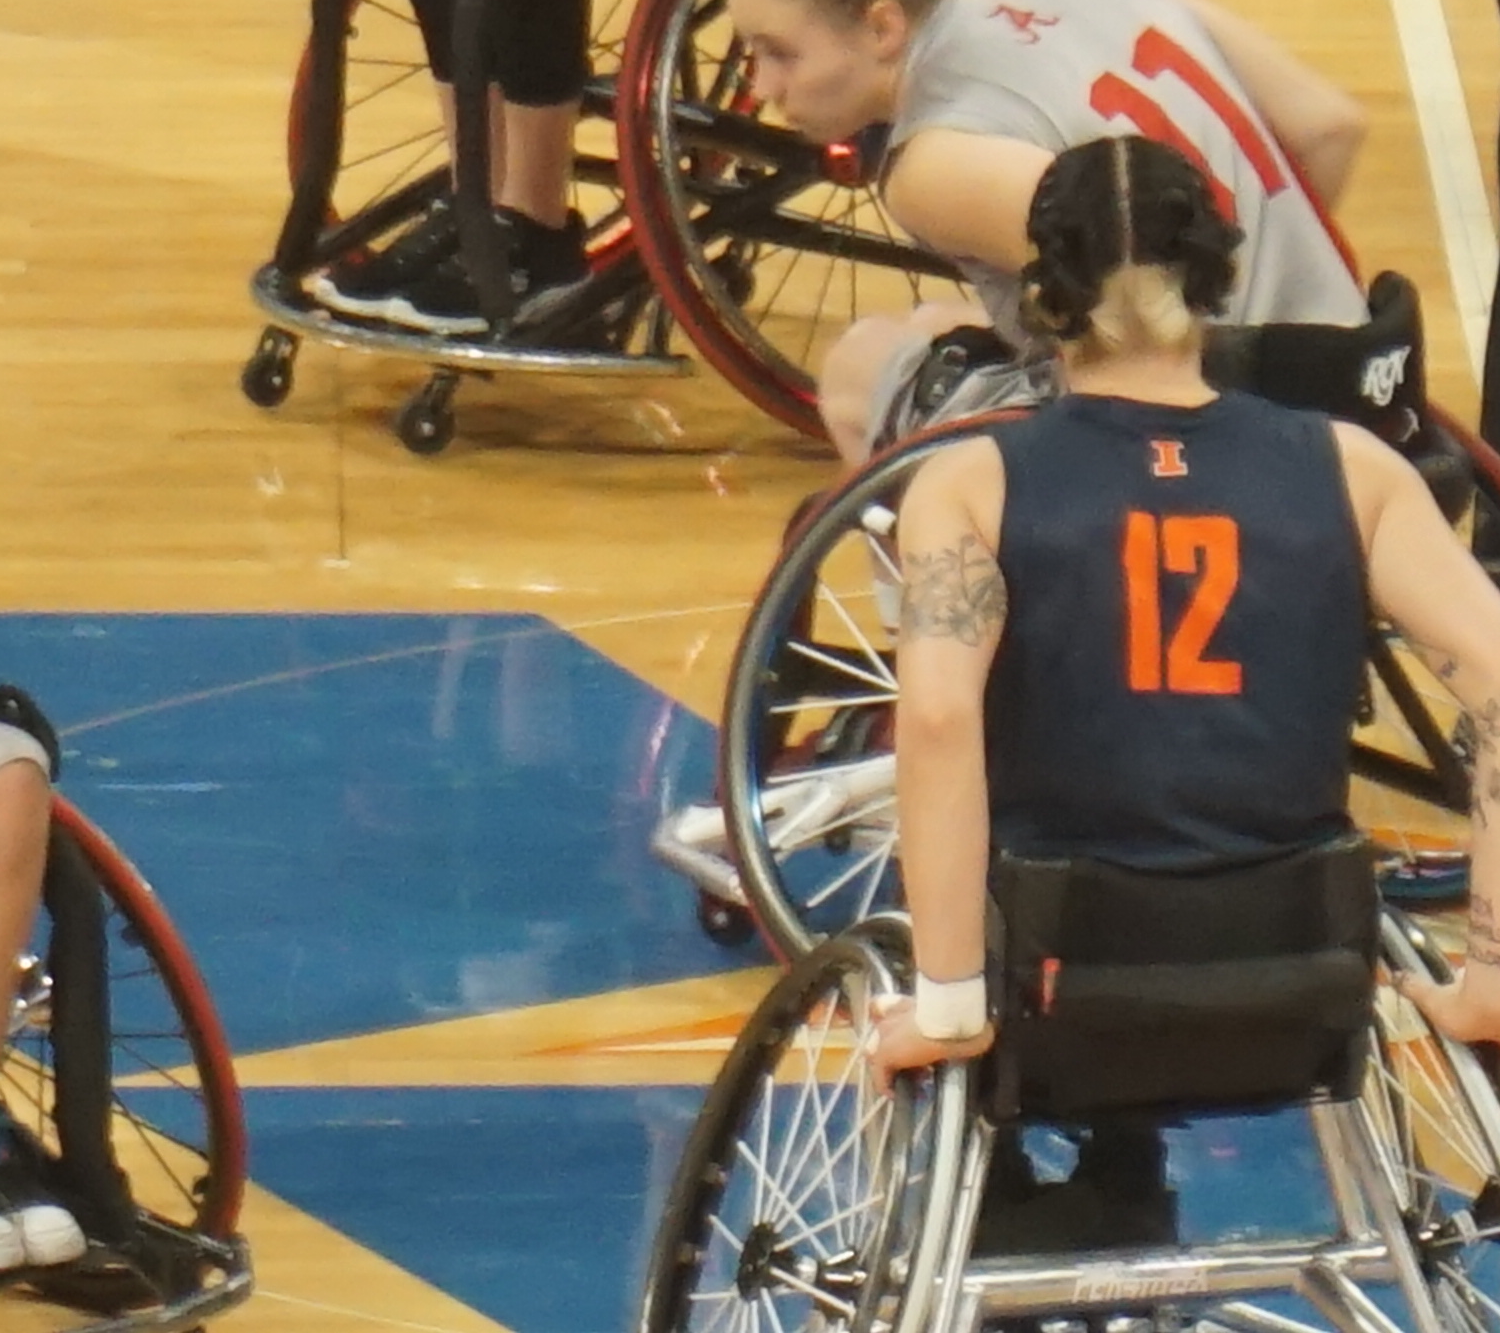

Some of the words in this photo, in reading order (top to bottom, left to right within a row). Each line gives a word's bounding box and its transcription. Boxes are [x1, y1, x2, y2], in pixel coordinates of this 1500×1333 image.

[1089, 26, 1289, 225] 11
[1150, 439, 1189, 477] I
[1124, 510, 1243, 696] 12
